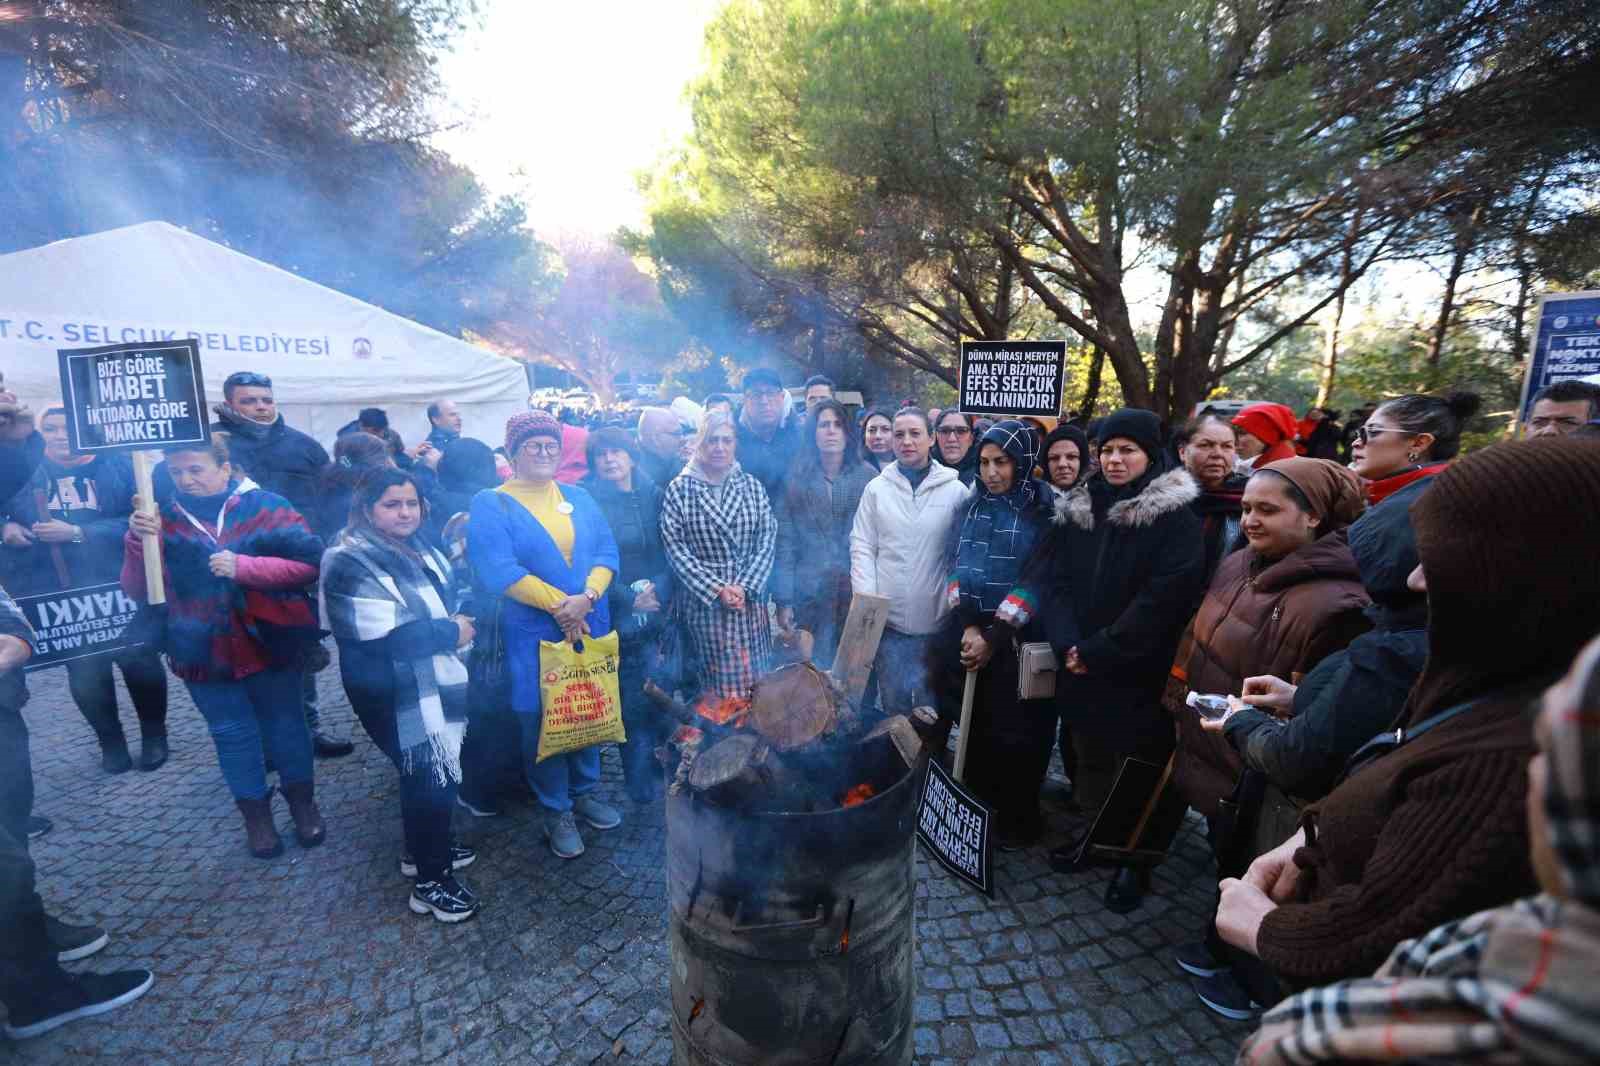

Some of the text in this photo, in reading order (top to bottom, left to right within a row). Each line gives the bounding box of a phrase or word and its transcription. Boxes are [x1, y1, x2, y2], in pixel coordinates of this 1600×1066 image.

[97, 354, 165, 378] BİZE GÖRE
[968, 348, 1058, 361] DÜNYA MİRASI MERYEM
[968, 360, 1057, 377] ANA EVİ BİZİMDİR
[99, 374, 167, 402] MABET
[966, 375, 1056, 394] EFES SELÇUK
[86, 399, 189, 425] İKTİDARA GÖRE
[965, 391, 1055, 409] HALKININDIR!
[104, 420, 175, 443] MARKET!
[36, 589, 137, 628] HAKKI
[52, 634, 82, 652] ANA
[925, 785, 945, 816] HAKKI
[923, 802, 938, 830] ANA
[958, 804, 982, 834] EFES
[937, 820, 979, 869] MERYEM
